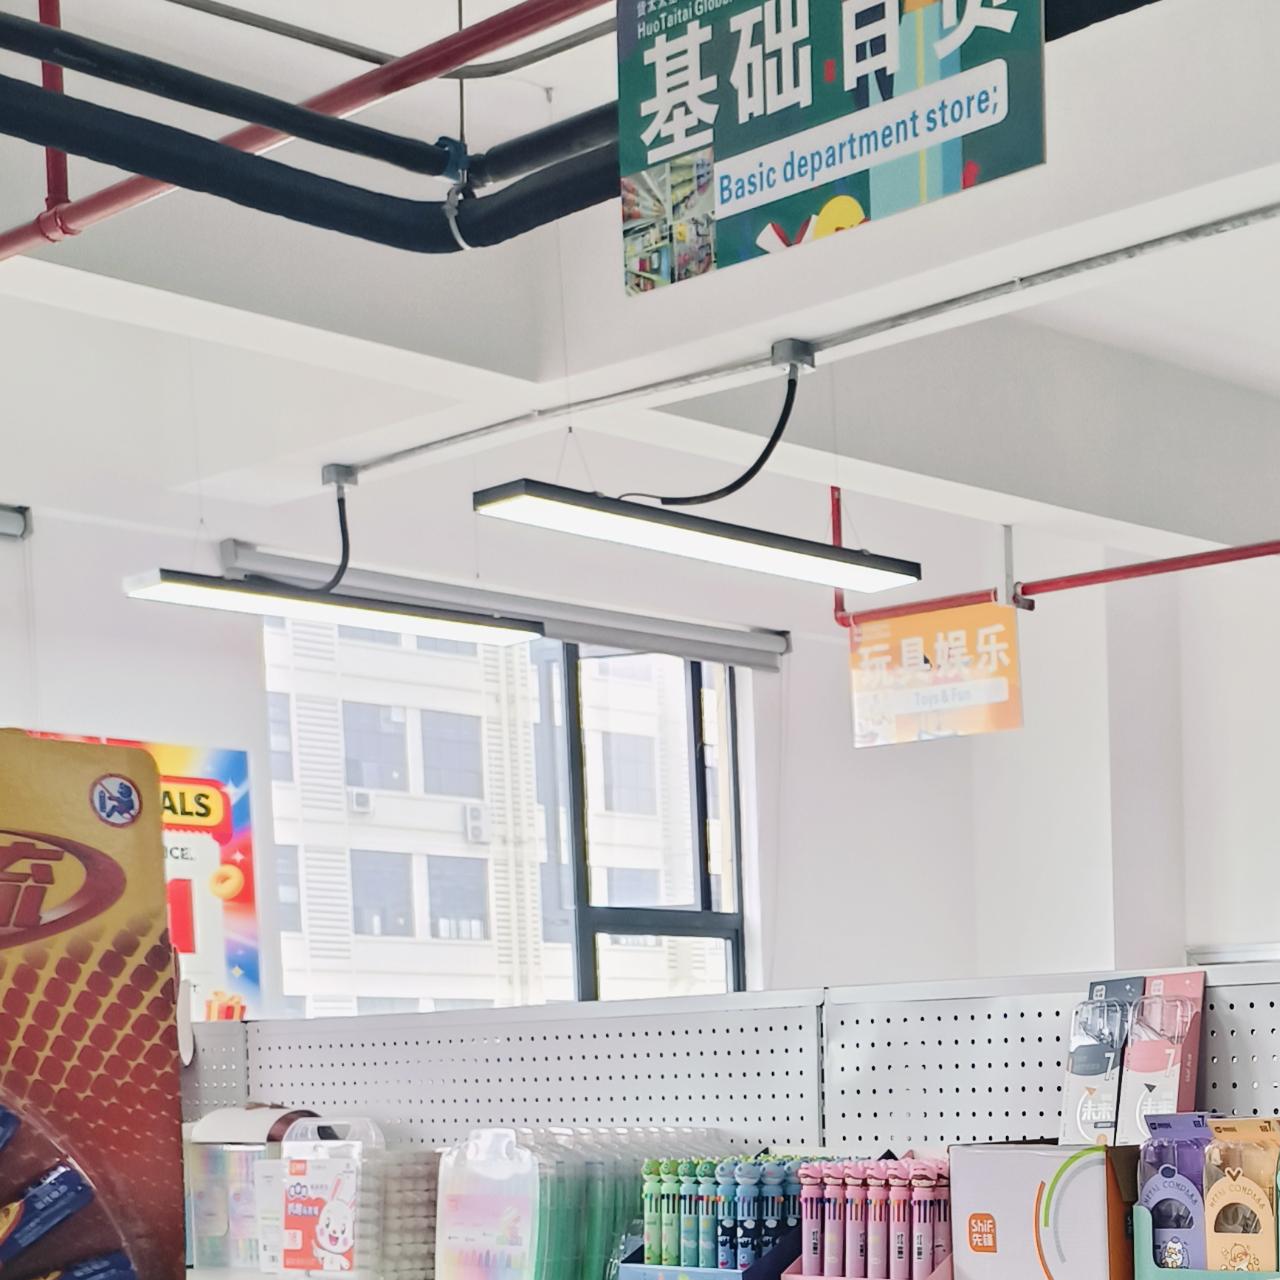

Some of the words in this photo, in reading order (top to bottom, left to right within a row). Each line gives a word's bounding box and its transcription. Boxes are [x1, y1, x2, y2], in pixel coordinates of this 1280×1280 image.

[637, 3, 693, 39] HuoTaitai
[718, 165, 777, 205] Basic
[783, 111, 919, 184] department
[858, 623, 1011, 687] 玩具娱乐
